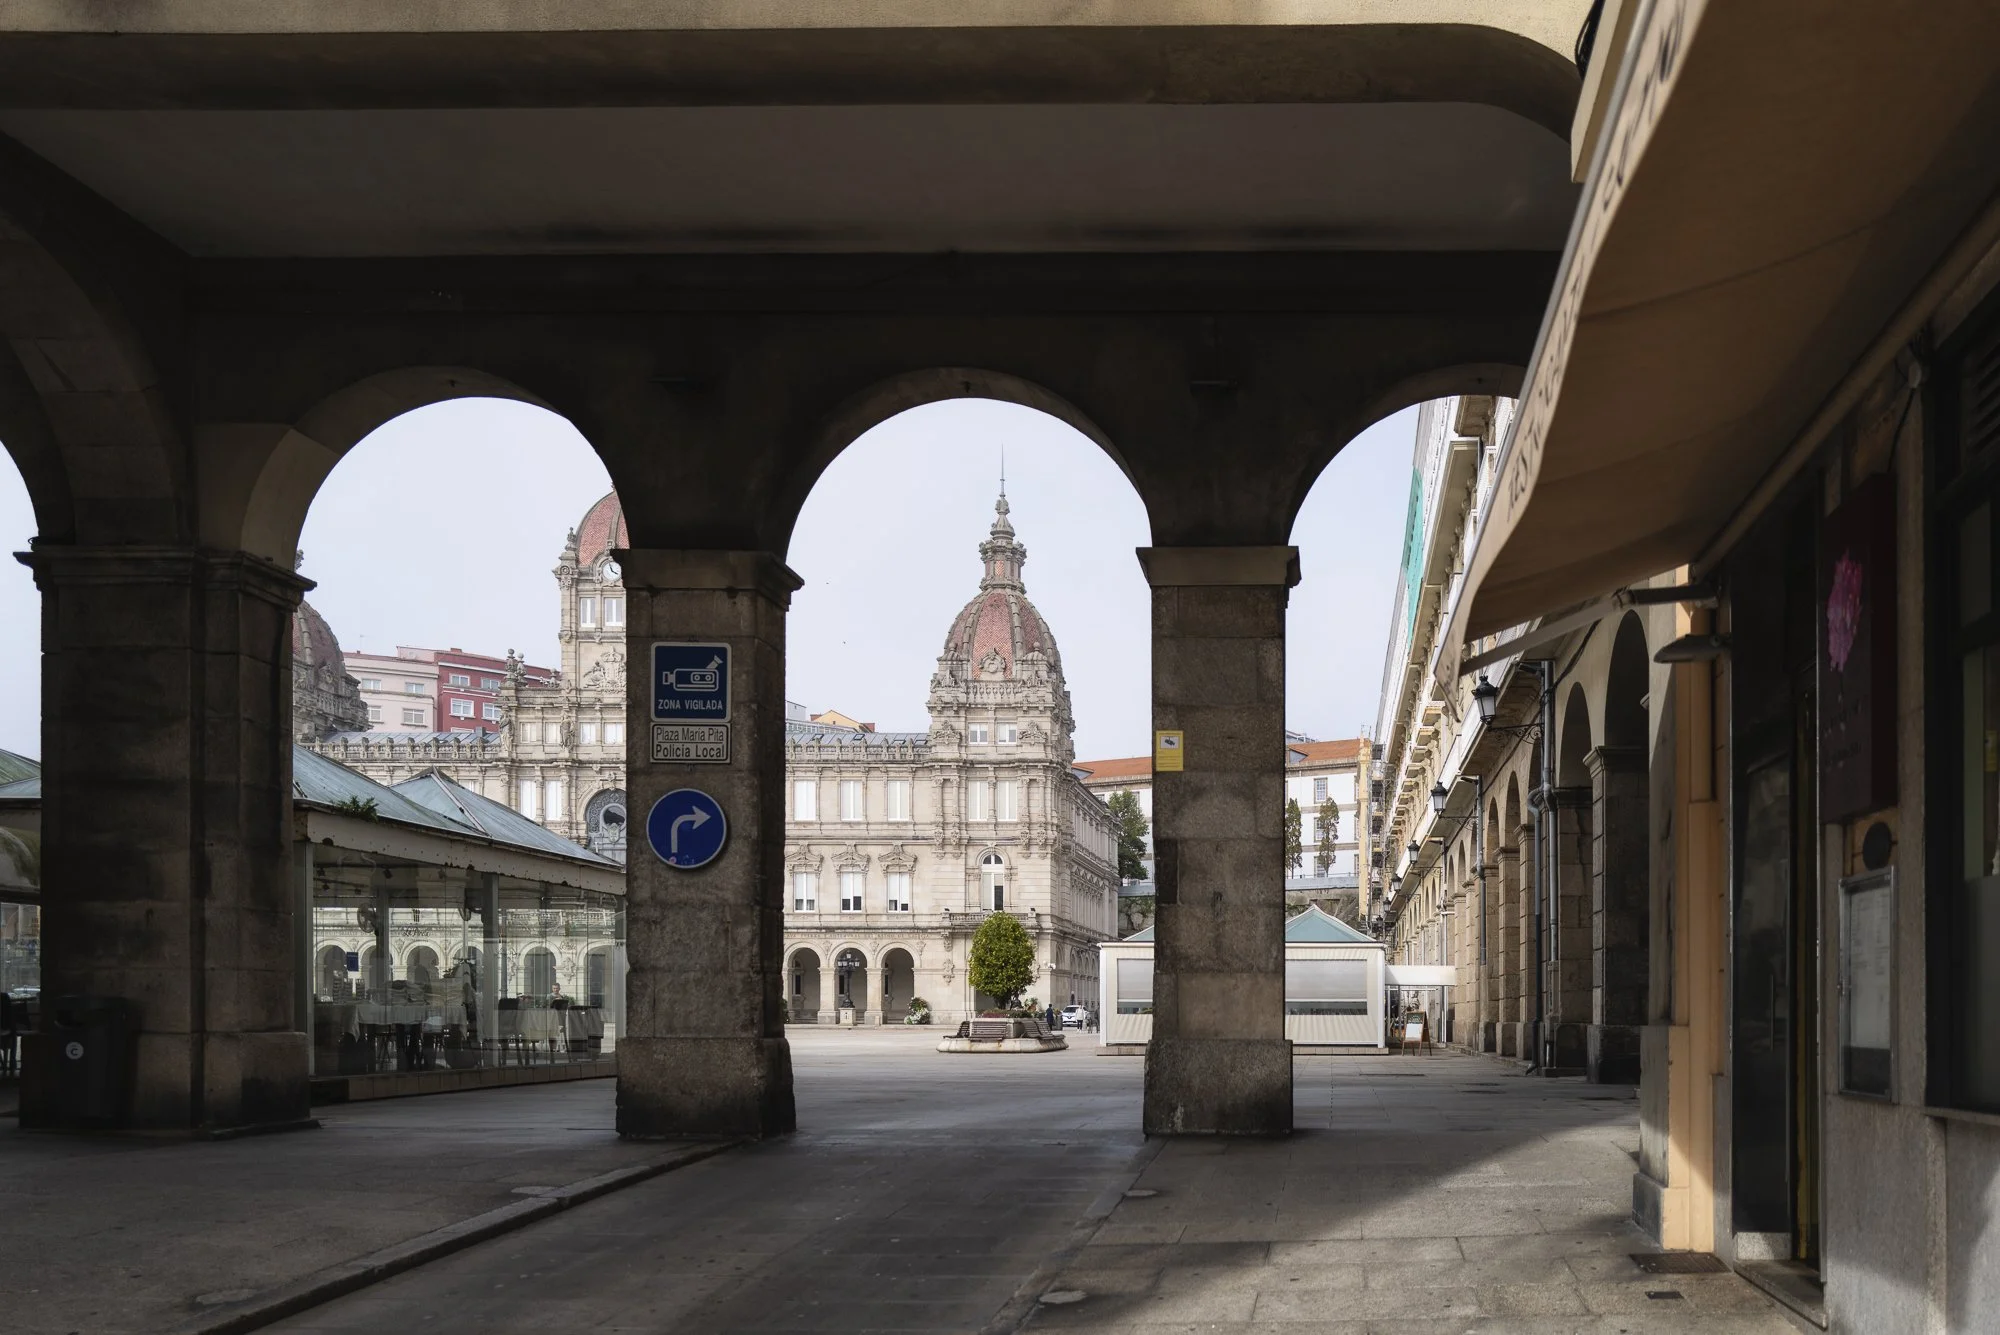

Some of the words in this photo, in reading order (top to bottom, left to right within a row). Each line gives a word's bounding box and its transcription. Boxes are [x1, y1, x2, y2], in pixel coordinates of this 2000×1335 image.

[658, 699, 681, 710] ZONA
[684, 699, 723, 710] VIGILADA
[656, 727, 679, 741] Plaza
[681, 728, 706, 741] María
[708, 728, 724, 742] Pita
[695, 744, 725, 758] Local
